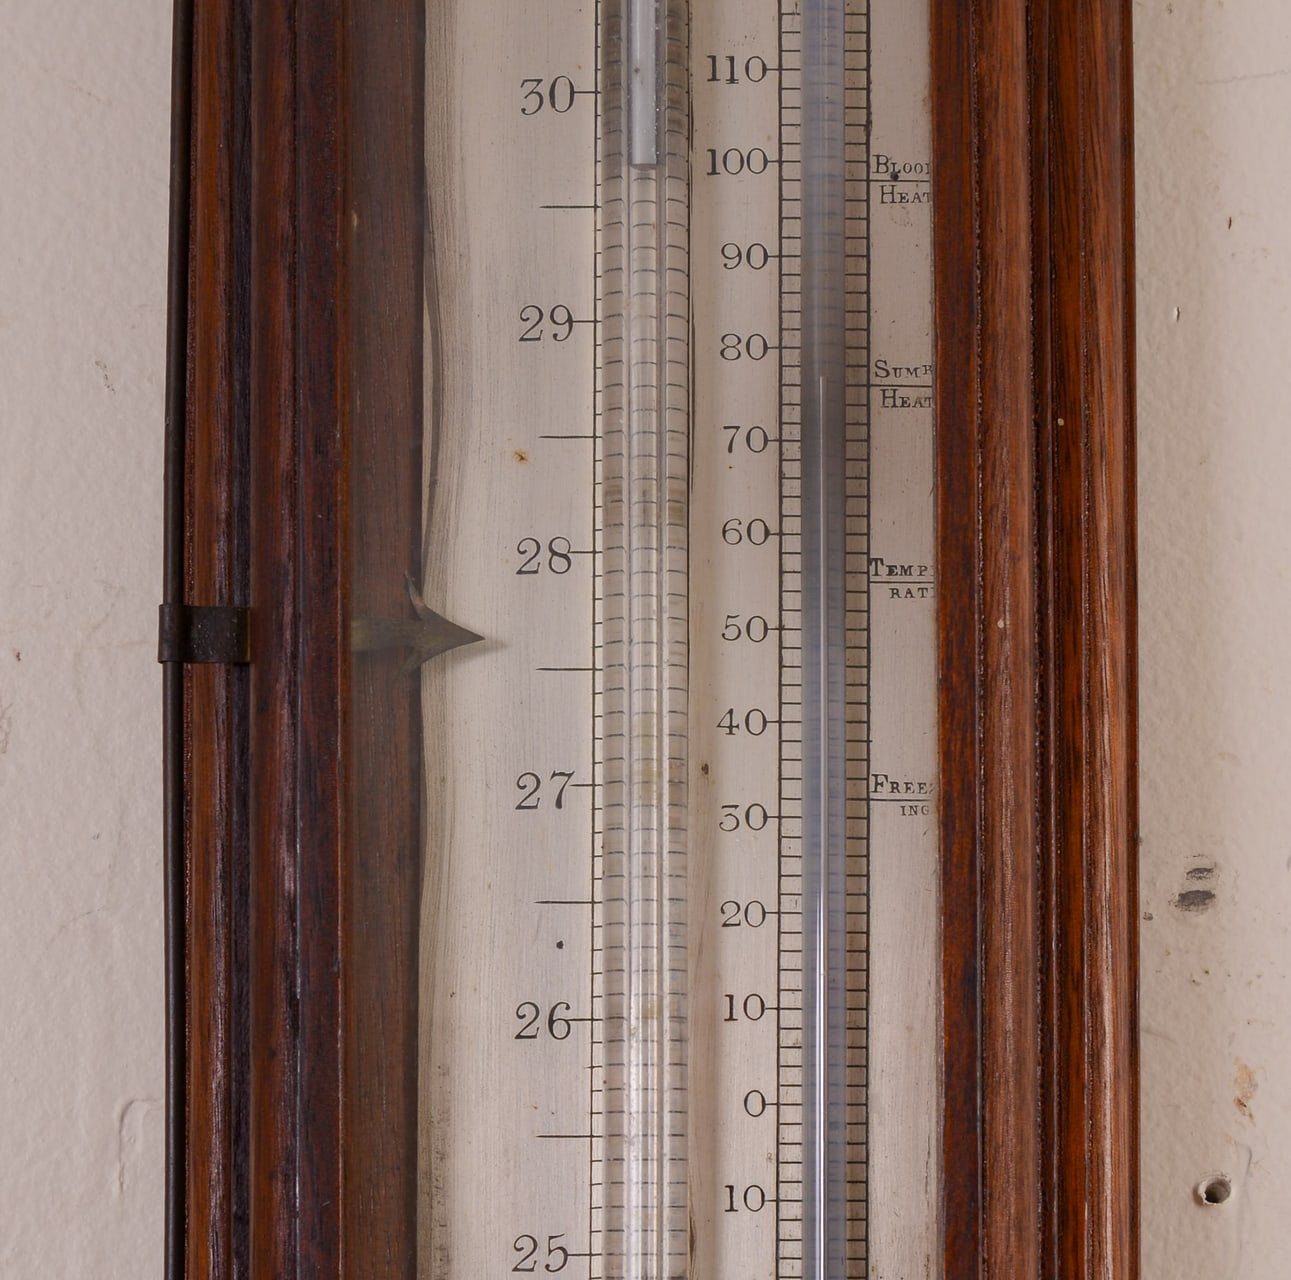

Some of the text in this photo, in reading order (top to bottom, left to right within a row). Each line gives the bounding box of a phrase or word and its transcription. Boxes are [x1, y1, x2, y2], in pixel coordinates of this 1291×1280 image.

[706, 55, 767, 84] 110
[519, 75, 575, 115] 30
[706, 148, 768, 177] 100
[721, 243, 768, 269] 90
[518, 305, 575, 342] 29
[720, 333, 768, 360] 80
[723, 425, 768, 452] 70
[721, 519, 768, 546] 60
[516, 537, 573, 575] 28
[721, 615, 768, 642] 50
[717, 708, 767, 736] 40
[515, 771, 575, 810] 27
[719, 804, 768, 831] 30
[719, 900, 767, 927] 20
[514, 1000, 572, 1041] 26
[723, 994, 766, 1021] 10
[743, 1091, 766, 1117] 0
[723, 1185, 766, 1212] 10
[511, 1234, 569, 1273] 25
